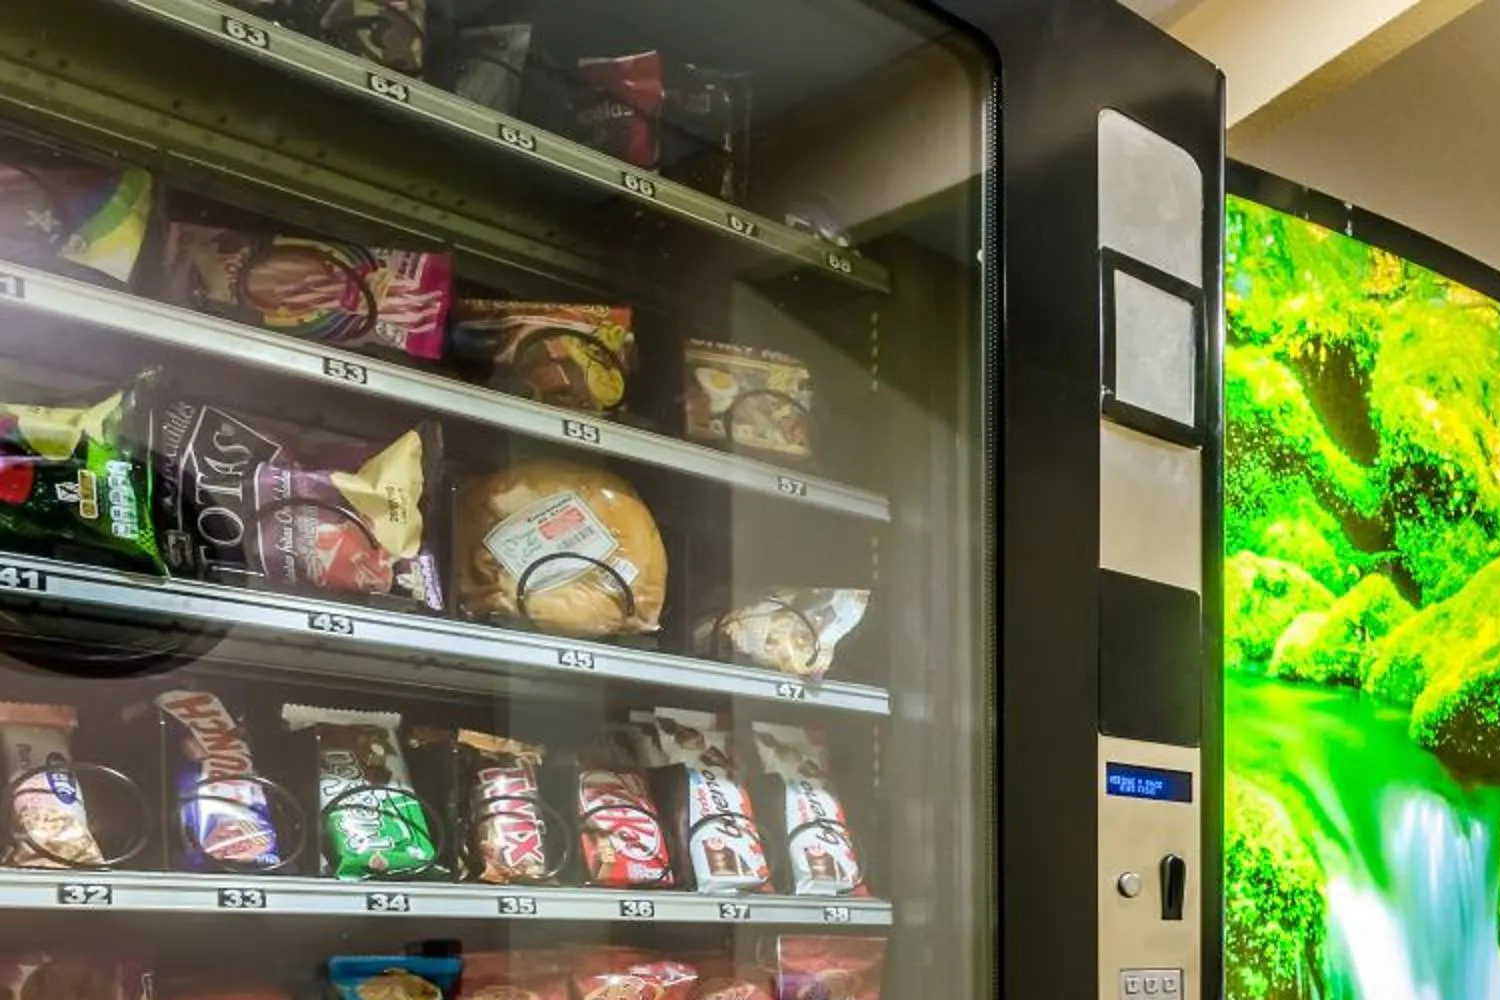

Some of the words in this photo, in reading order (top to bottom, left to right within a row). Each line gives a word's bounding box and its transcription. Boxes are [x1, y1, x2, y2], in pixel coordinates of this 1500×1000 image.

[226, 20, 268, 46] 63
[370, 75, 407, 100] 64
[502, 128, 534, 149] 65
[625, 175, 654, 197] 66
[730, 215, 755, 235] 67
[327, 360, 364, 383] 53
[567, 424, 598, 441] 55
[779, 478, 805, 494] 57
[0, 566, 38, 589] 41
[314, 616, 352, 634] 43
[561, 651, 593, 667] 45
[479, 760, 544, 867] TWIX
[64, 886, 110, 903] 32
[223, 890, 265, 907] 33
[370, 895, 407, 911] 34
[502, 898, 534, 913] 35
[624, 902, 652, 916] 36
[722, 904, 748, 918] 37
[826, 909, 848, 921] 38
